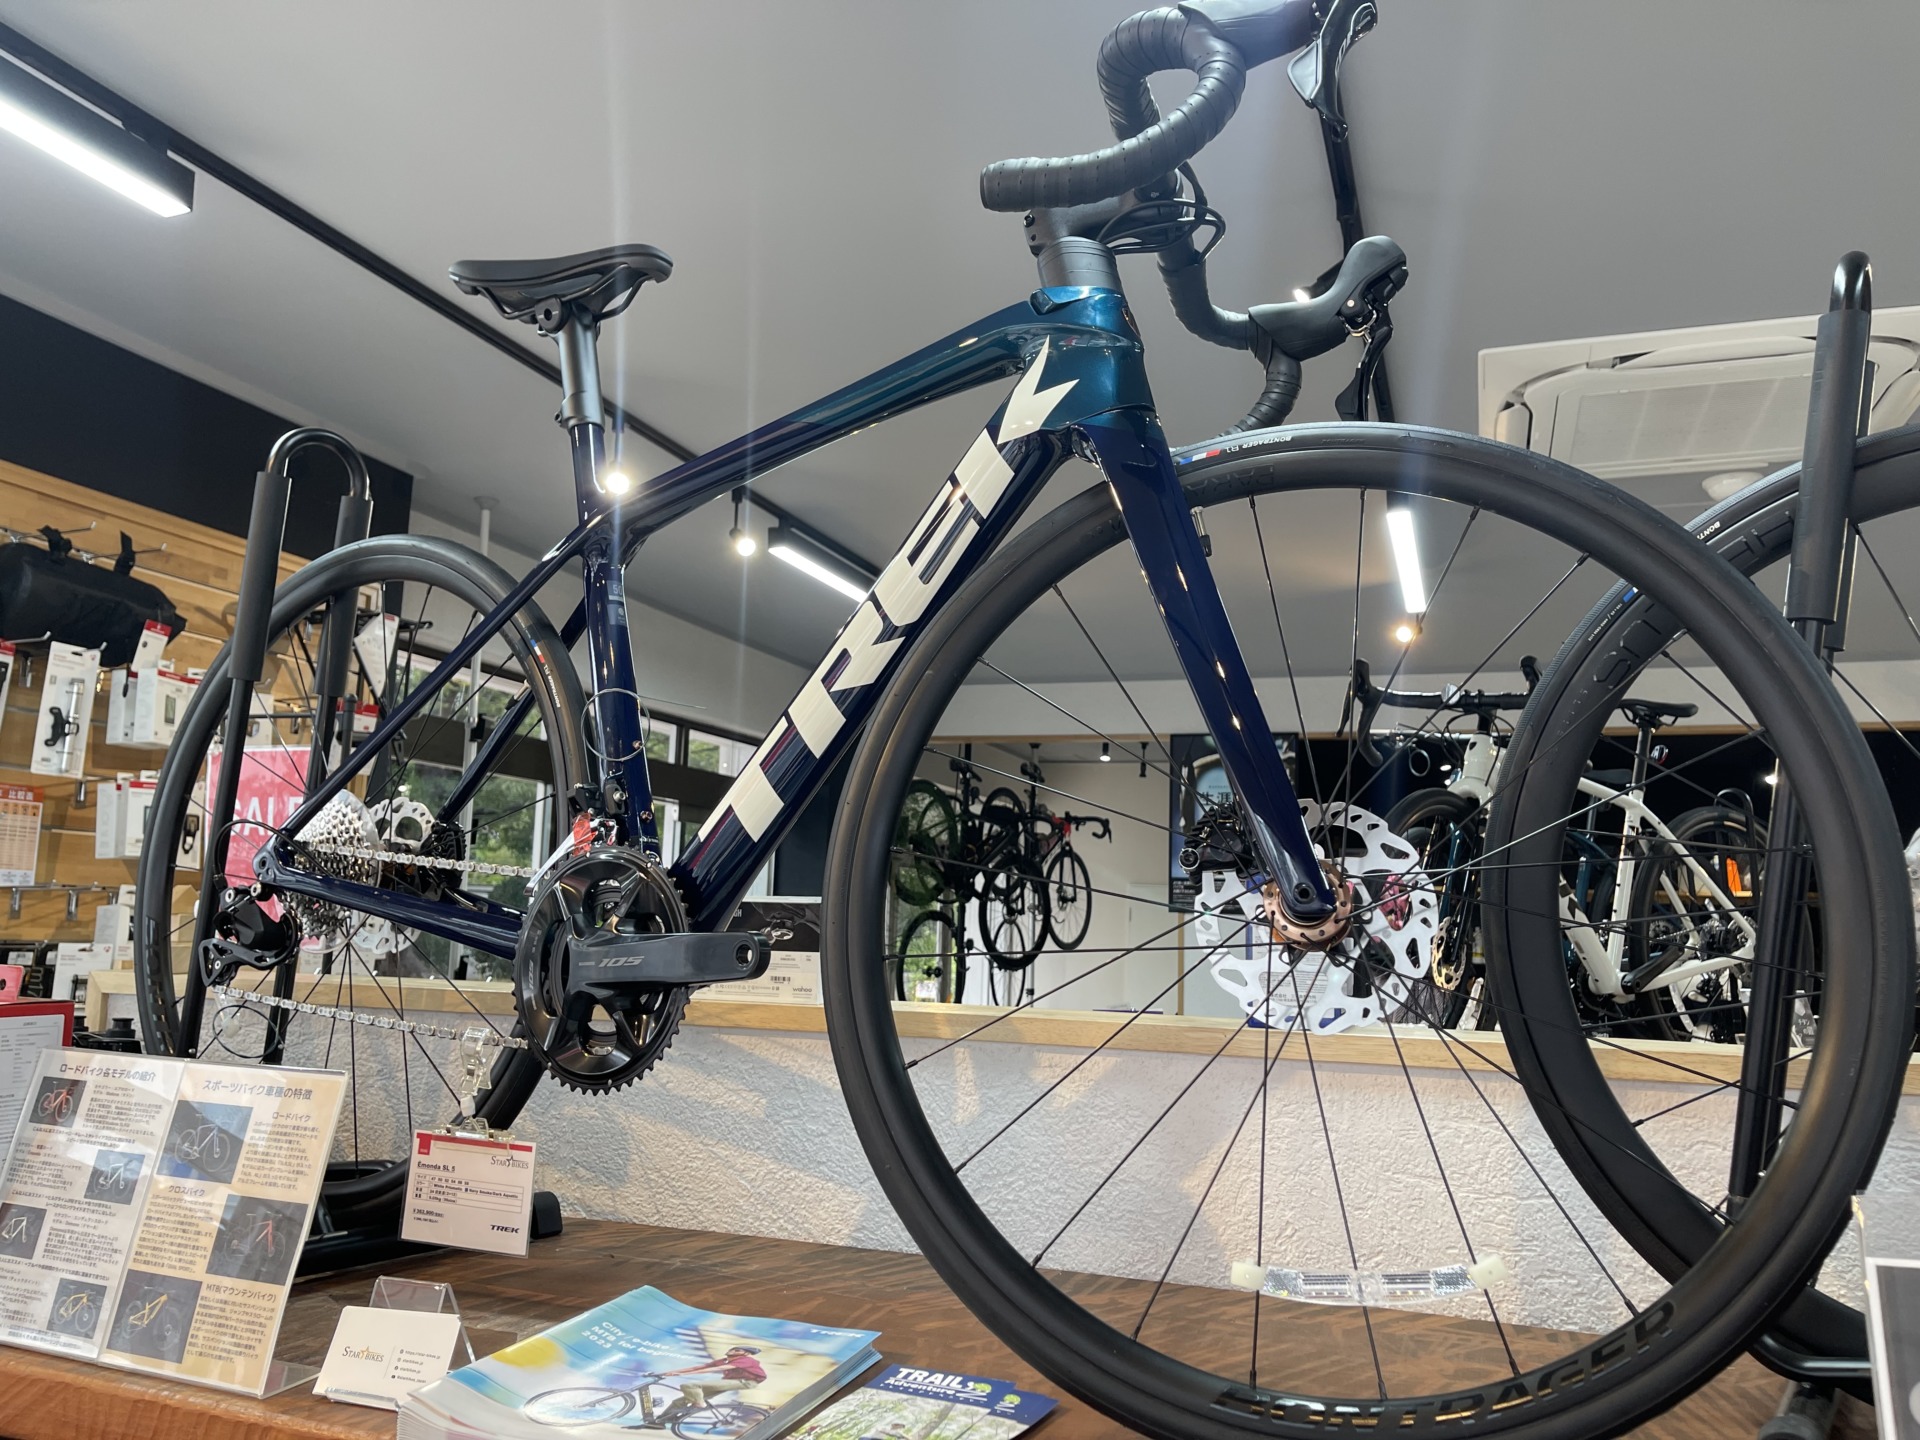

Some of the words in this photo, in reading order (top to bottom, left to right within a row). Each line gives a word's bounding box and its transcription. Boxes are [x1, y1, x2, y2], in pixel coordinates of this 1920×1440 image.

[1225, 445, 1240, 453] R1
[1242, 435, 1293, 449] BONTRAGER
[698, 335, 1080, 843] TREK
[598, 955, 645, 967] 105
[60, 1064, 156, 1081] ロードバイク各モデルの紹介
[202, 1080, 313, 1100] スポーツバイク車種の特徴
[272, 1111, 311, 1122] ロードバイク
[490, 1155, 507, 1167] STAR
[511, 1160, 529, 1169] BIKES
[168, 1185, 205, 1196] クロスバイク
[490, 1224, 520, 1234] TREK
[581, 1330, 613, 1349] 2023
[591, 1325, 617, 1342] MTB
[618, 1340, 636, 1349] for
[602, 1321, 626, 1337] City
[632, 1338, 670, 1350] e-bike
[342, 1346, 361, 1359] STAR
[364, 1353, 385, 1363] BIKES
[894, 1367, 963, 1389] TRAIL
[884, 1378, 956, 1396] Adventure
